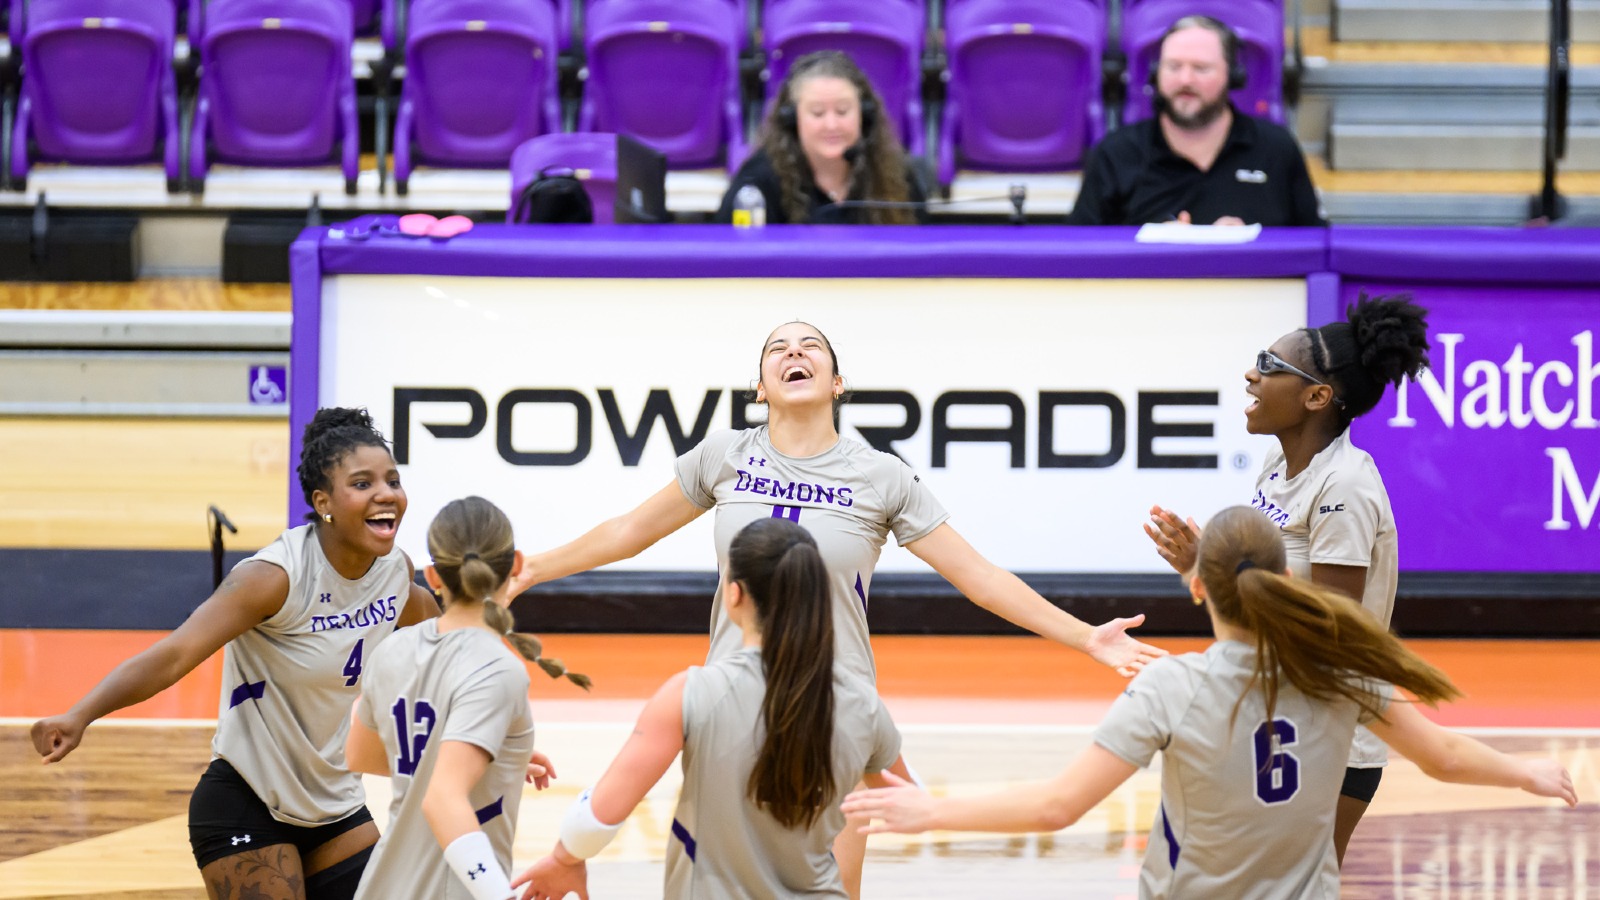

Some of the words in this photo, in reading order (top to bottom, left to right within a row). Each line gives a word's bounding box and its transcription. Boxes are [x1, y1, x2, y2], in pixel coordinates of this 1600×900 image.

[734, 469, 854, 507] DEMONS
[1319, 503, 1345, 515] SLC
[342, 638, 365, 687] 4
[391, 696, 437, 778] 12
[1253, 717, 1299, 806] 6
